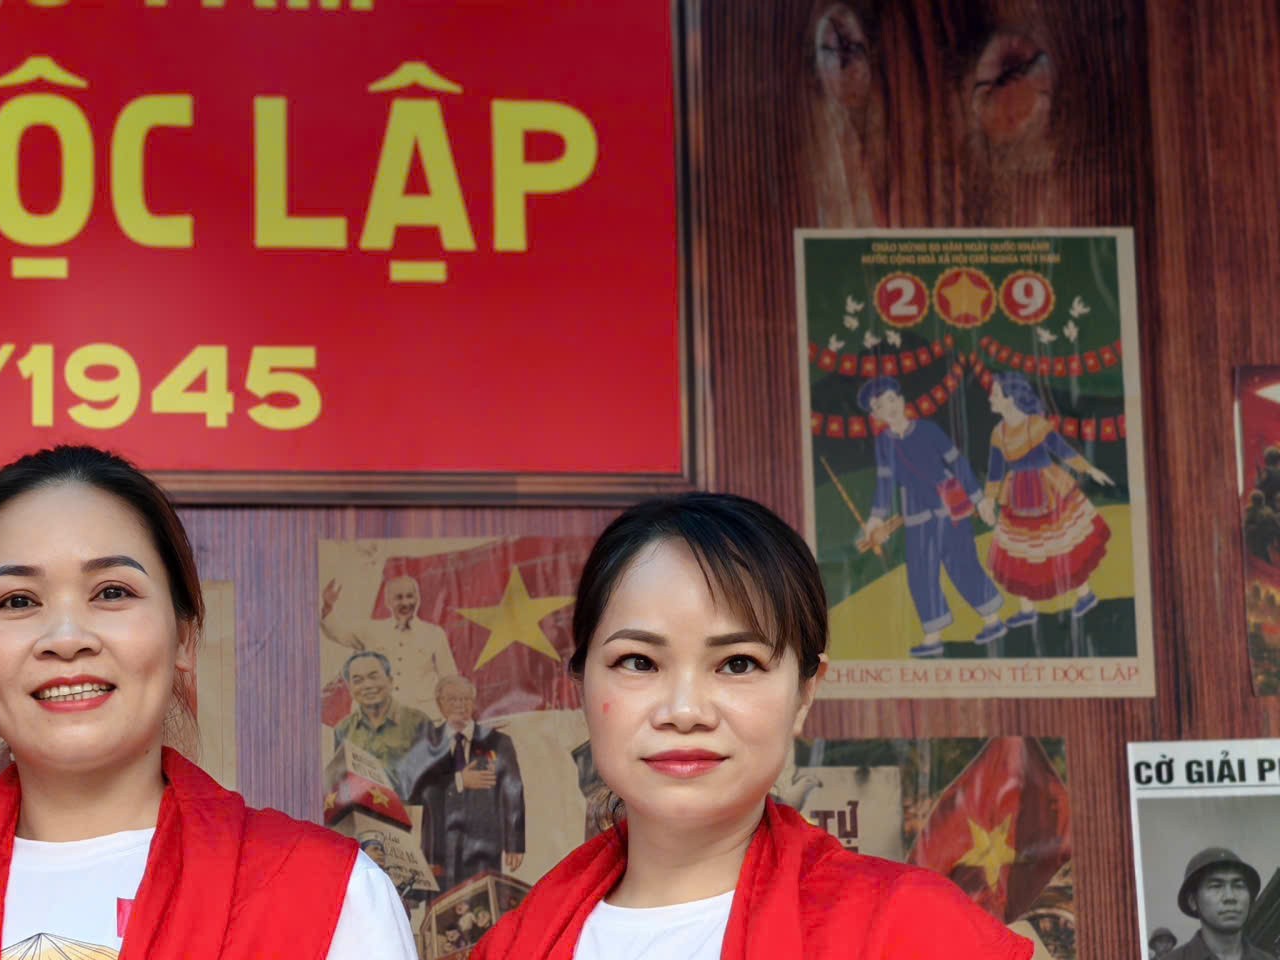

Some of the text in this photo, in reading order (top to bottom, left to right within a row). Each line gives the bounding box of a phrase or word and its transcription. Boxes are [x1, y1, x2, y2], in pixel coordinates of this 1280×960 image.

[254, 61, 598, 282] LẬP
[886, 276, 1046, 316] 2 9
[899, 669, 928, 684] EM
[1134, 750, 1280, 785] CỜ GIẢI P
